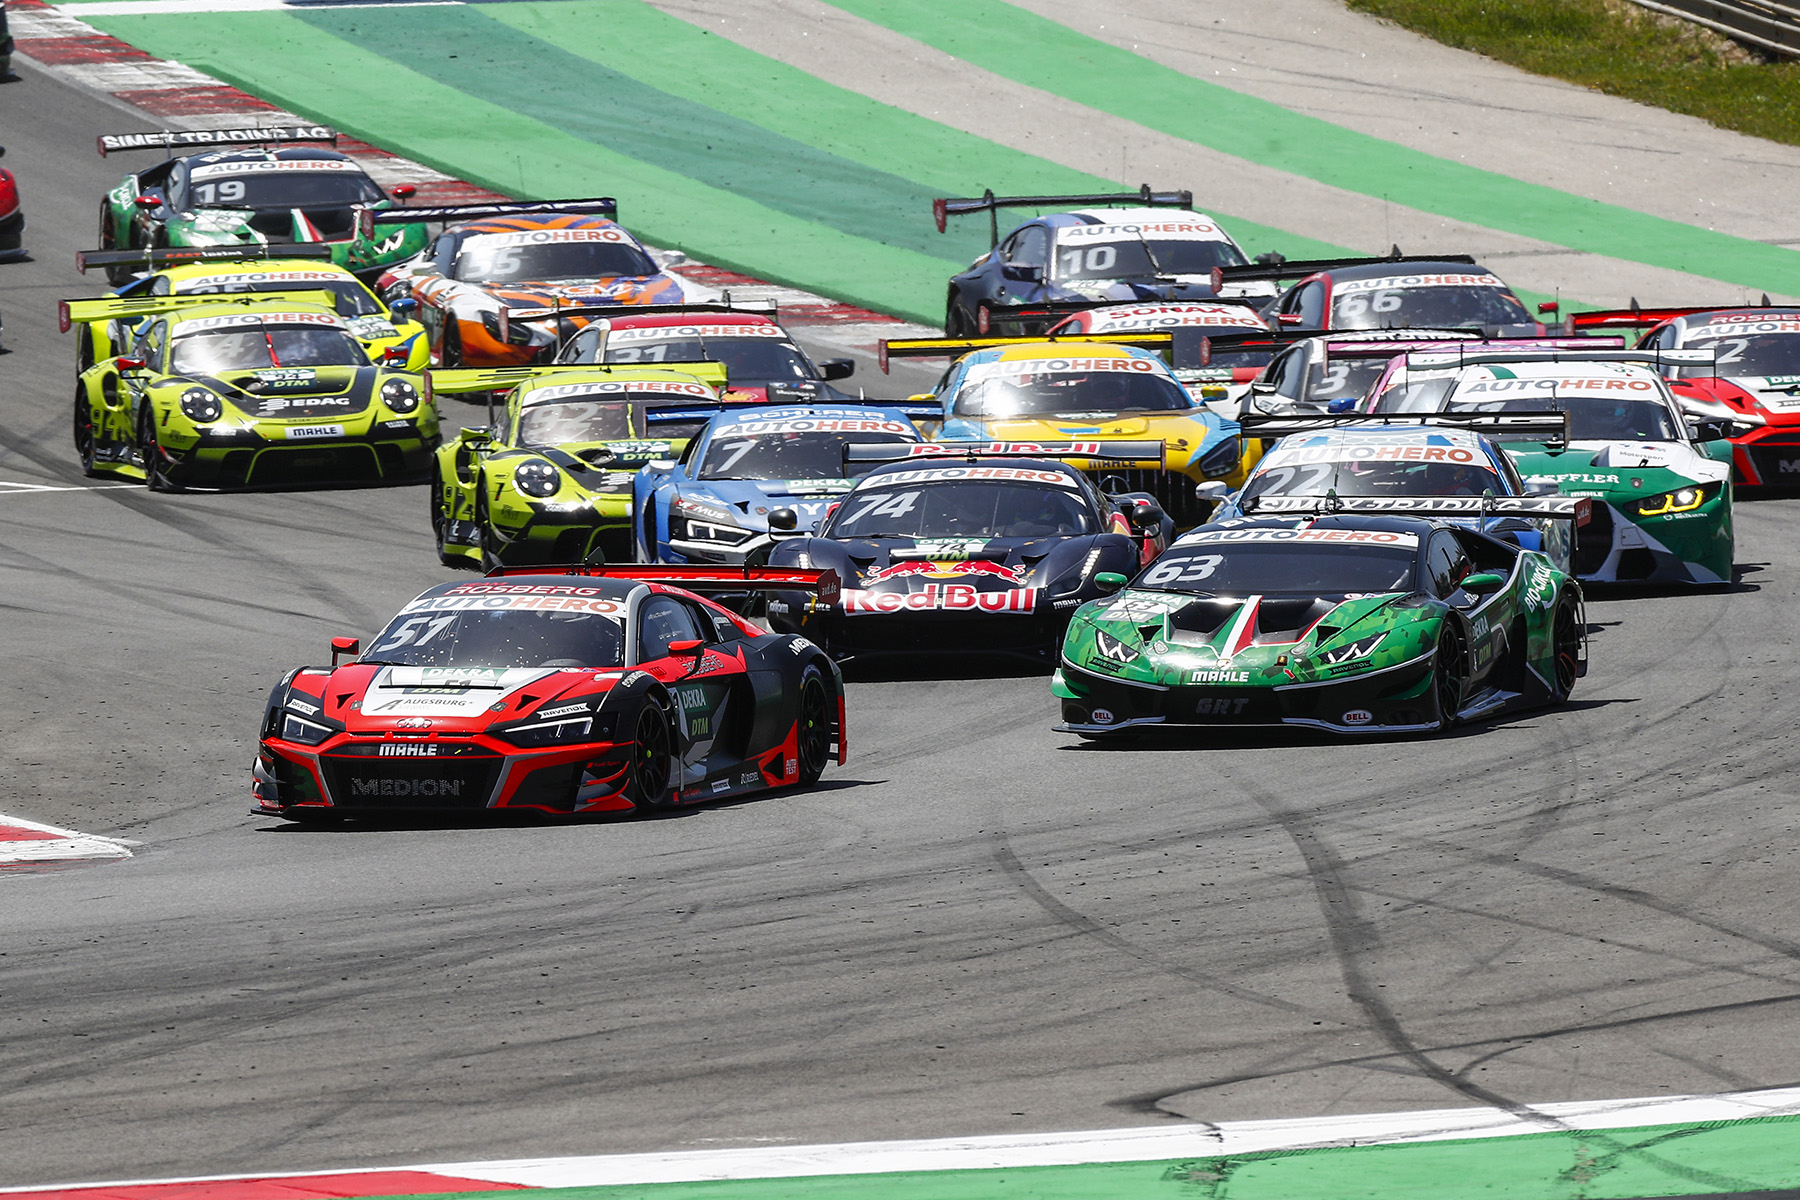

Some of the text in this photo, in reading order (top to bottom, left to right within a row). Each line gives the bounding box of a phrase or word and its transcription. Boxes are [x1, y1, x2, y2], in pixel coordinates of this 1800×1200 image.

[102, 125, 332, 149] SIMEX TRADING AG
[209, 160, 344, 173] AUTOHERO
[195, 179, 246, 203] 19
[1066, 223, 1213, 237] AUTOHERO
[1061, 246, 1117, 275] 10
[196, 272, 340, 286] AUTOHERO
[1344, 275, 1496, 291] AUTOHERO
[1338, 289, 1403, 317] 66
[1110, 306, 1230, 319] SONAX
[183, 312, 336, 332] AUTOHERO
[1100, 316, 1258, 331] AUTOHERO
[366, 331, 396, 339] DTM
[617, 324, 777, 340] AUTOHERO
[986, 360, 1152, 373] AUTOHERO
[1320, 366, 1350, 394] 3
[1464, 379, 1652, 394] AUTOHERO
[536, 382, 705, 400] AUTOHERO
[292, 397, 350, 407] EDAG
[738, 409, 886, 421] SCHERER
[292, 427, 338, 437] MAHLE
[727, 420, 905, 434] AUTOHERO
[622, 453, 663, 461] DTM
[716, 441, 757, 473] 7
[1276, 447, 1474, 463] AUTOHERO
[1619, 450, 1664, 461] Motorsport
[789, 479, 852, 488] DEKRA
[872, 468, 1064, 487] AUTOHERO
[1264, 465, 1332, 496] 22
[1520, 473, 1620, 484] AEFFLER
[840, 491, 921, 525] 74
[1524, 500, 1575, 512] AG
[1201, 531, 1399, 543] AUTOHERO
[1143, 555, 1223, 585] 63
[443, 585, 602, 596] ROSBERG
[407, 597, 618, 613] AUTOHERO
[842, 583, 1039, 616] Red Bull
[1127, 591, 1184, 605] DEKRA
[1105, 611, 1149, 620] DTM
[427, 668, 496, 678] DEKRA
[1332, 662, 1370, 673] RAVENOL
[1191, 671, 1249, 682] MAHLE
[681, 689, 706, 709] DEKRA
[543, 705, 586, 716] RAVENOL
[1196, 698, 1249, 715] GRT
[1094, 712, 1111, 720] BELL
[1346, 712, 1369, 721] BELL
[691, 719, 709, 736] DTM
[379, 743, 437, 757] MAHLE
[352, 778, 460, 796] MEDION
